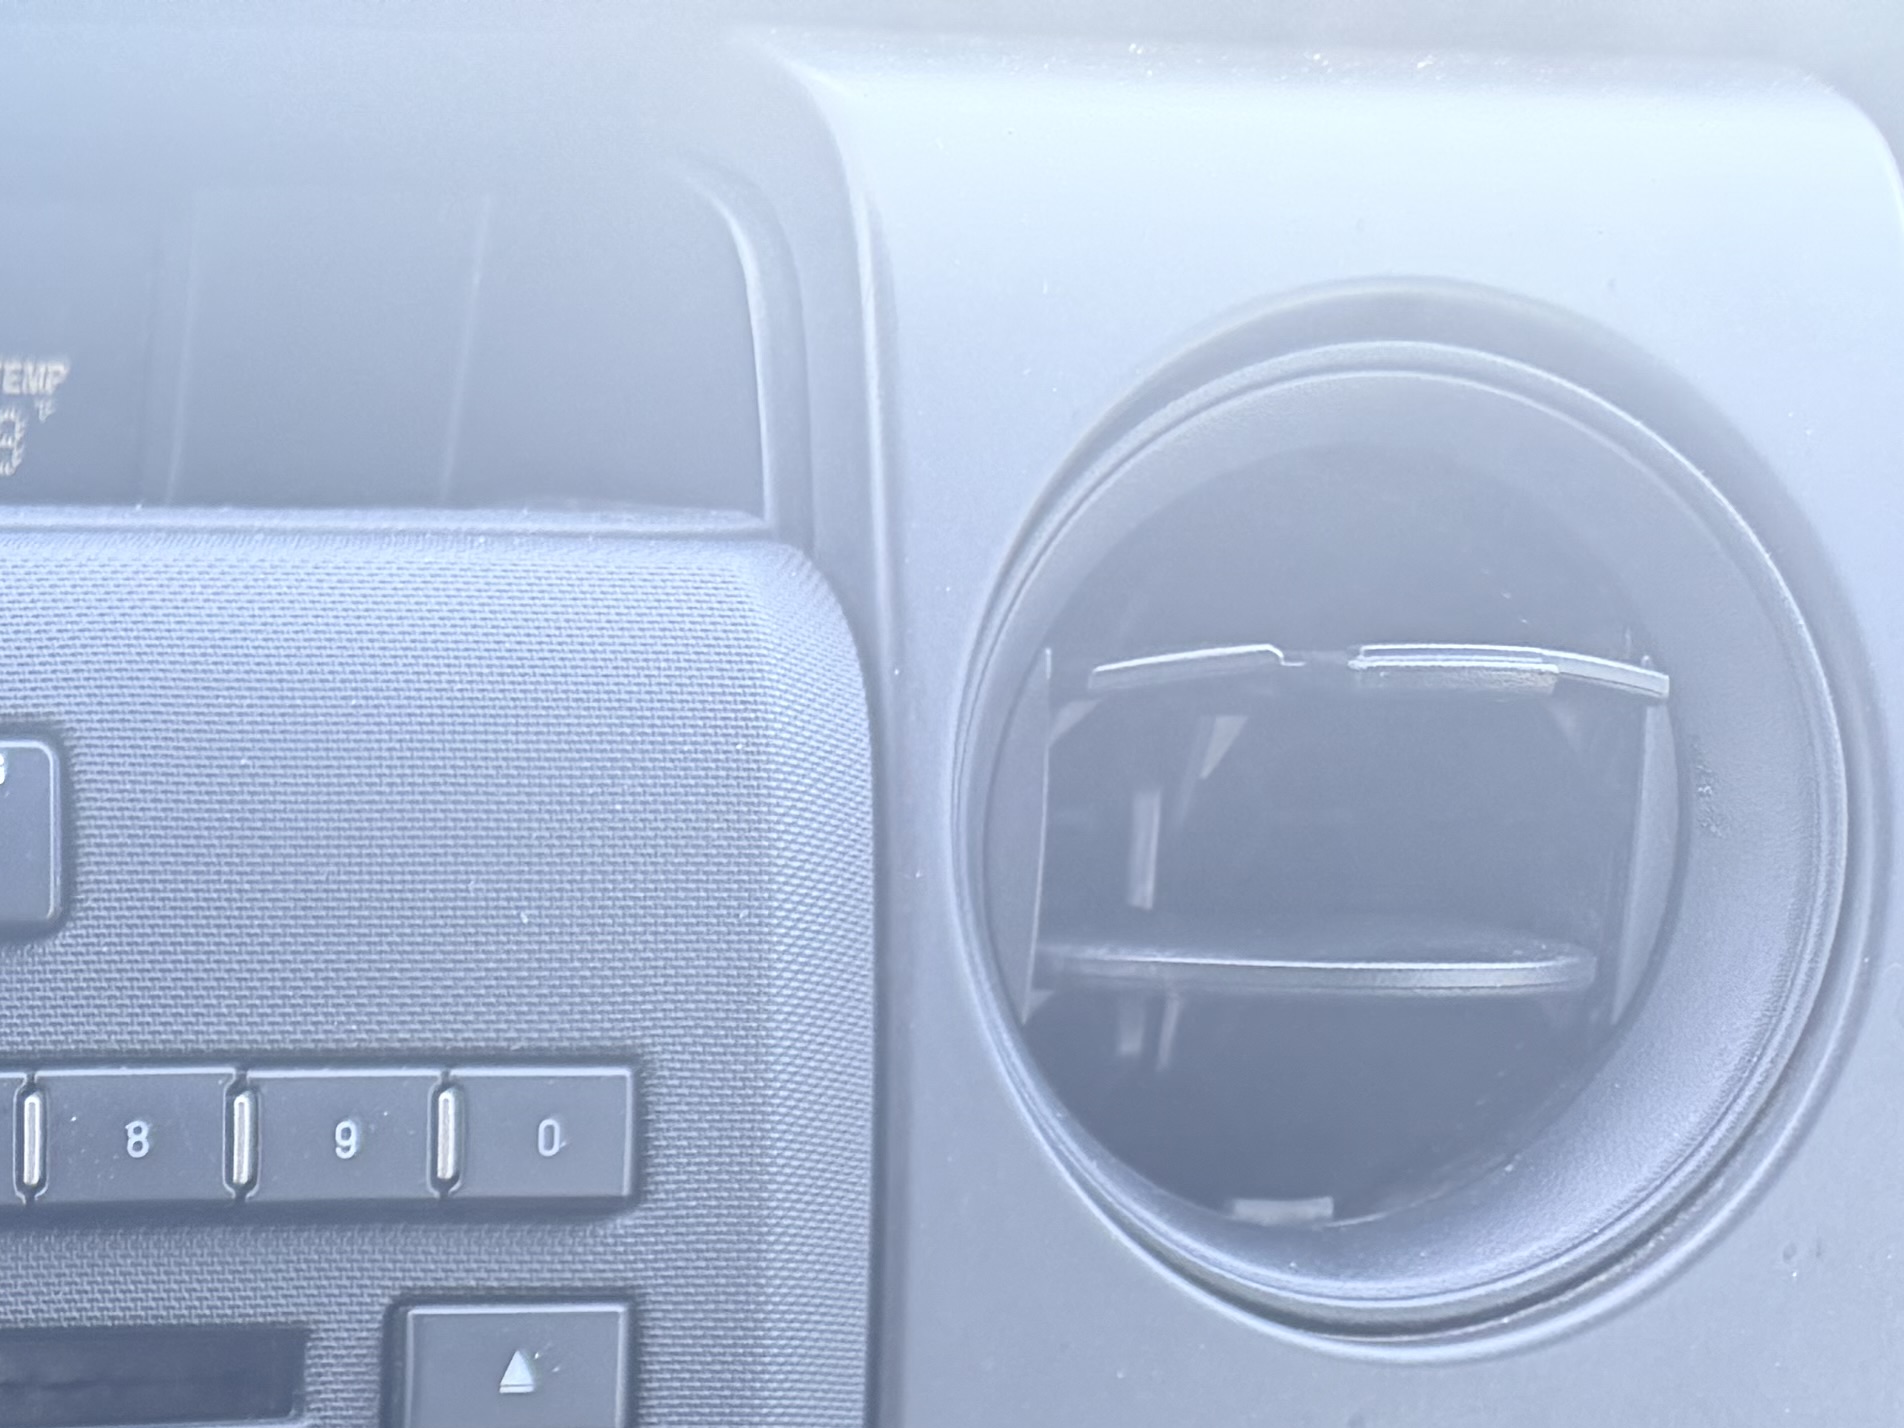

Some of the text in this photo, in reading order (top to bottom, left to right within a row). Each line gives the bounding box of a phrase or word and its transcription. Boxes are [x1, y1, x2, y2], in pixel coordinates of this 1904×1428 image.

[125, 1119, 151, 1158] 8
[335, 1119, 360, 1159] 9
[537, 1117, 562, 1157] 0
